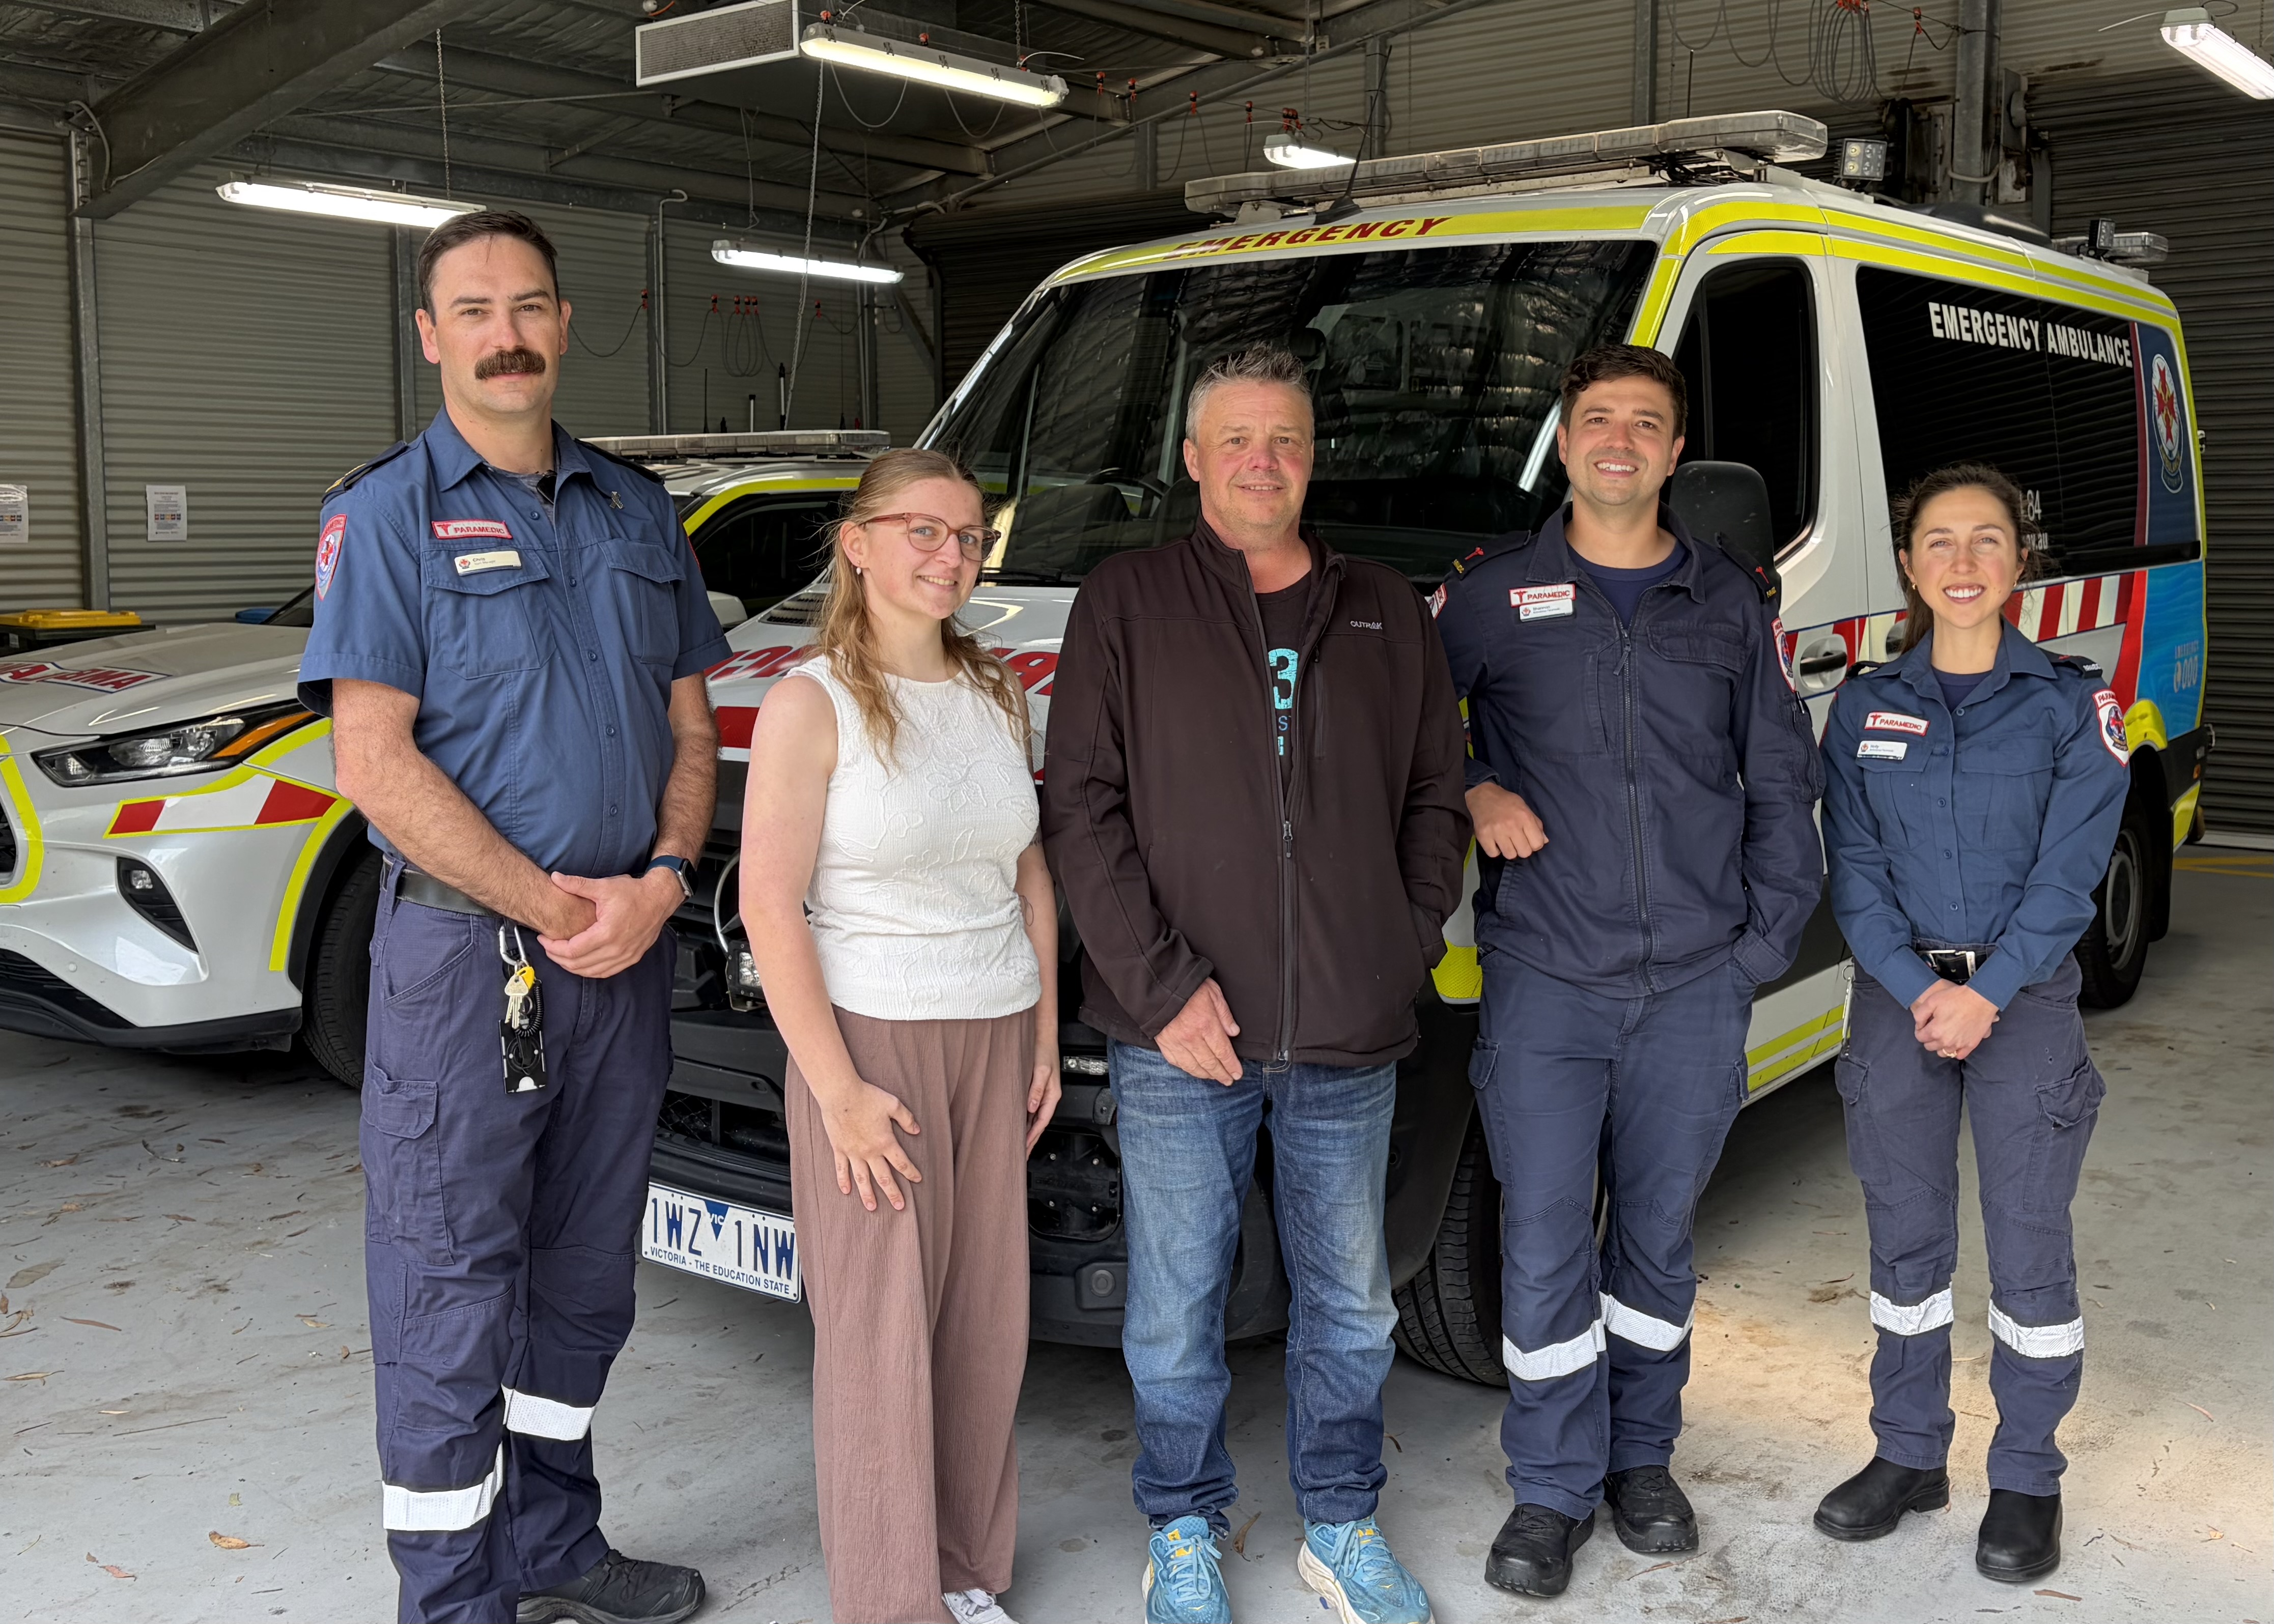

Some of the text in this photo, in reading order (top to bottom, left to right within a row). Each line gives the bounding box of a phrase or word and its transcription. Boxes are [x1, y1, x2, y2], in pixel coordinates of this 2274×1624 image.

[1163, 217, 1451, 260] EMERGENCY
[1928, 301, 2133, 368] EMERGENCY AMBULANCE
[1528, 590, 1570, 601] PARAMEDIC
[1350, 620, 1383, 630] OUTRAK
[1879, 719, 1922, 730] PARAMEDIC
[652, 1198, 795, 1280] 1WZ 1NW
[651, 1246, 687, 1265] VICTORIA
[694, 1260, 710, 1272] THE
[713, 1264, 761, 1287] EDUCATION
[764, 1279, 790, 1294] STATE
